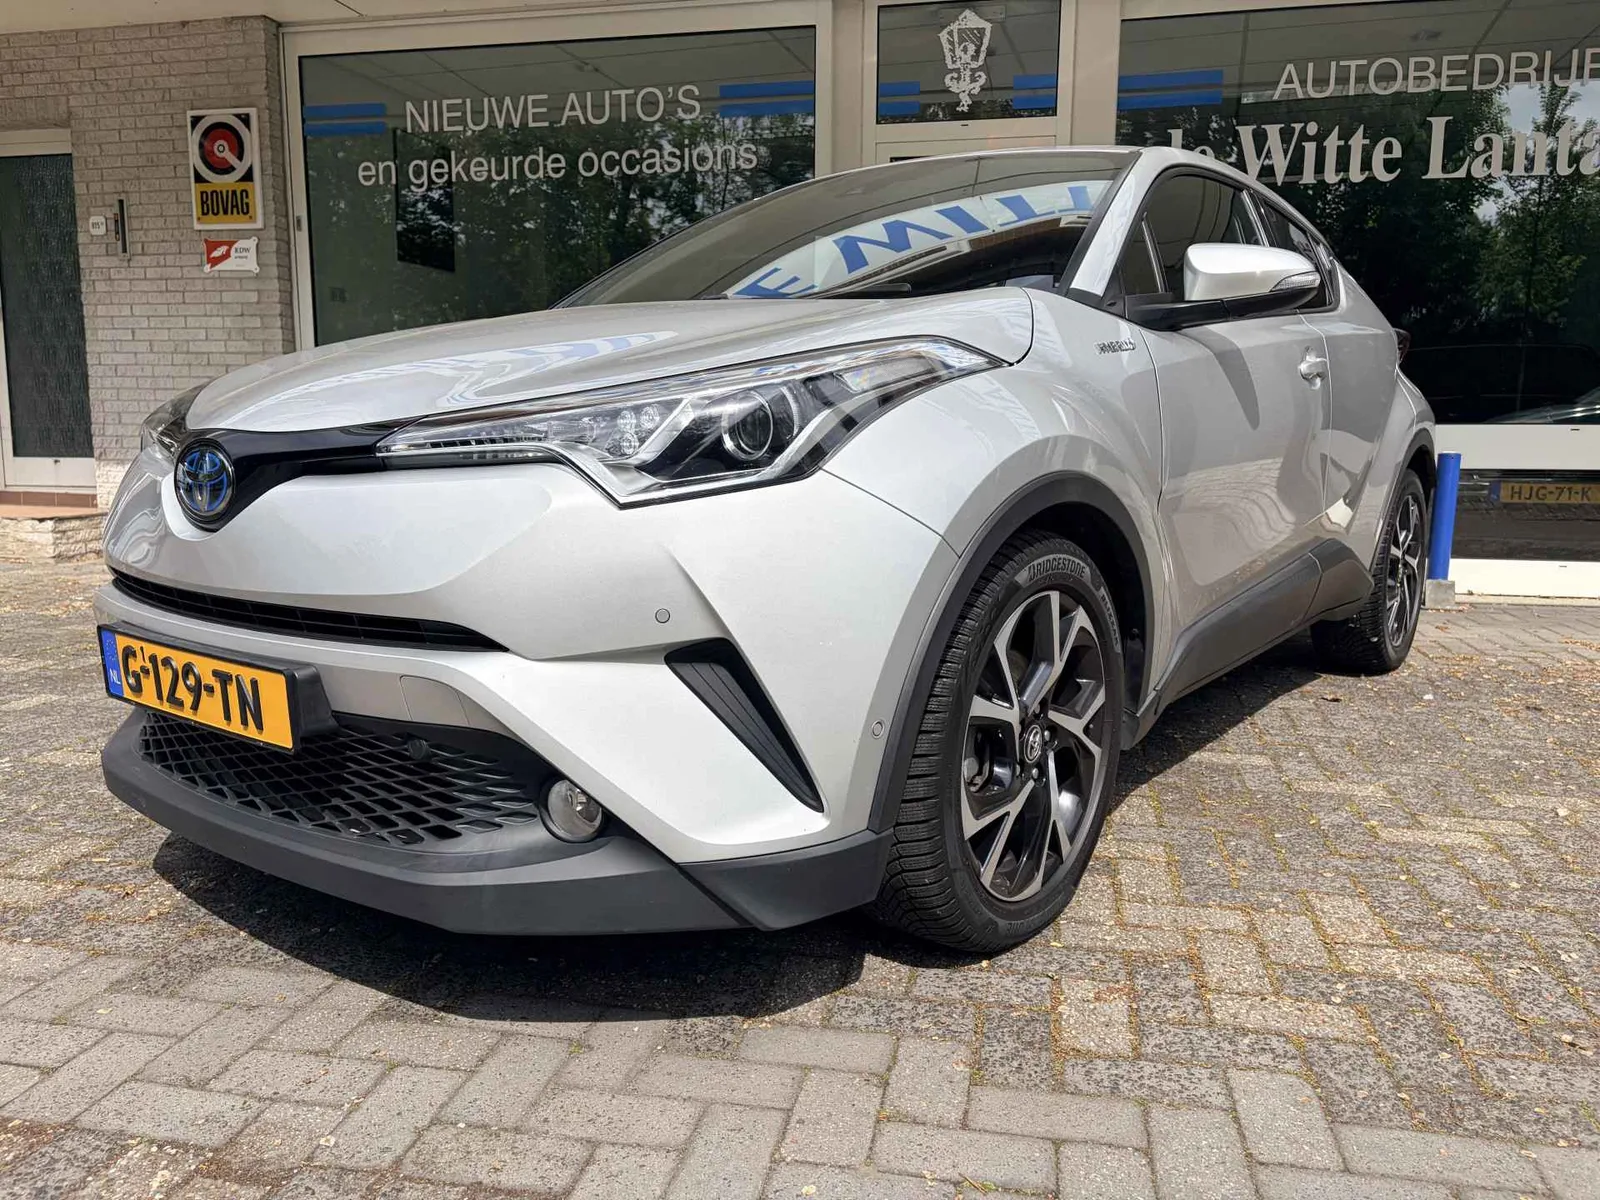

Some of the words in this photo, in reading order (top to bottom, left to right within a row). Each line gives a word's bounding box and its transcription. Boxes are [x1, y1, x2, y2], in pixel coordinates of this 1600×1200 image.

[405, 94, 550, 133] NIEUWE
[560, 84, 702, 126] AUTO'S
[358, 158, 397, 187] en
[408, 146, 567, 194] gekeurde
[577, 138, 758, 179] occasions
[1236, 119, 1402, 187] Witte
[200, 189, 250, 216] BOVAG
[1510, 486, 1592, 501] HJG-71-K
[1028, 557, 1086, 581] BRIDGESTONE
[110, 668, 121, 685] NL
[121, 645, 264, 731] G-129-TN
